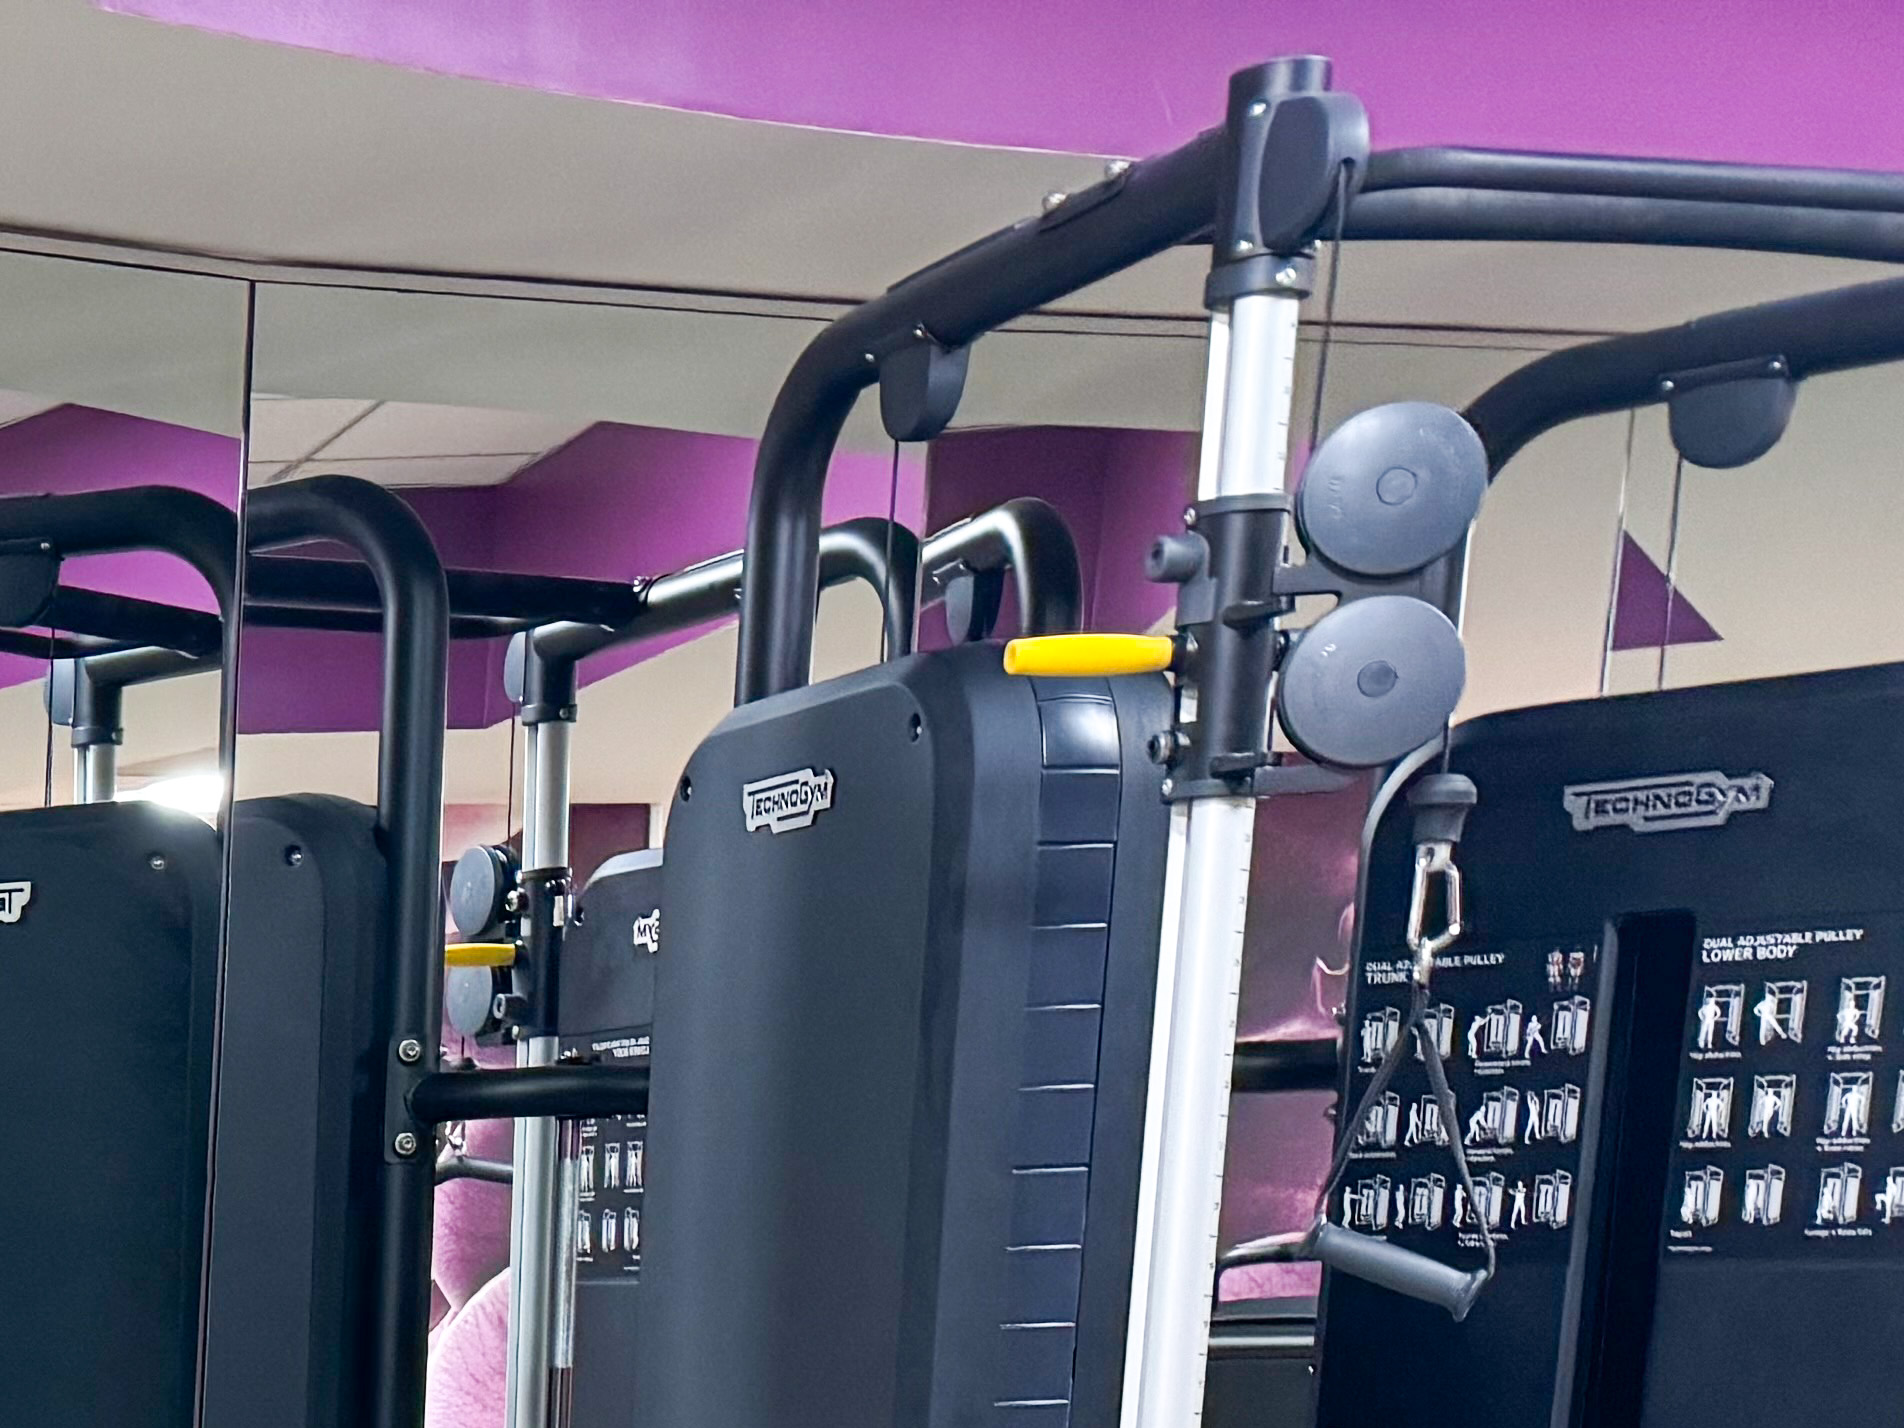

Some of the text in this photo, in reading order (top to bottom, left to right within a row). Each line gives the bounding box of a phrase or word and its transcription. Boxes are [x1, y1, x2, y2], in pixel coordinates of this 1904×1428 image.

[748, 778, 829, 821] TECHNOGYM
[1571, 780, 1762, 822] TECHNOGYM
[1702, 929, 1864, 950] DUAL ADJUSTABLE PULLEY
[1464, 952, 1505, 966] PULLEY
[1701, 945, 1798, 963] LOWER BODY
[1365, 971, 1409, 985] TRUNK
